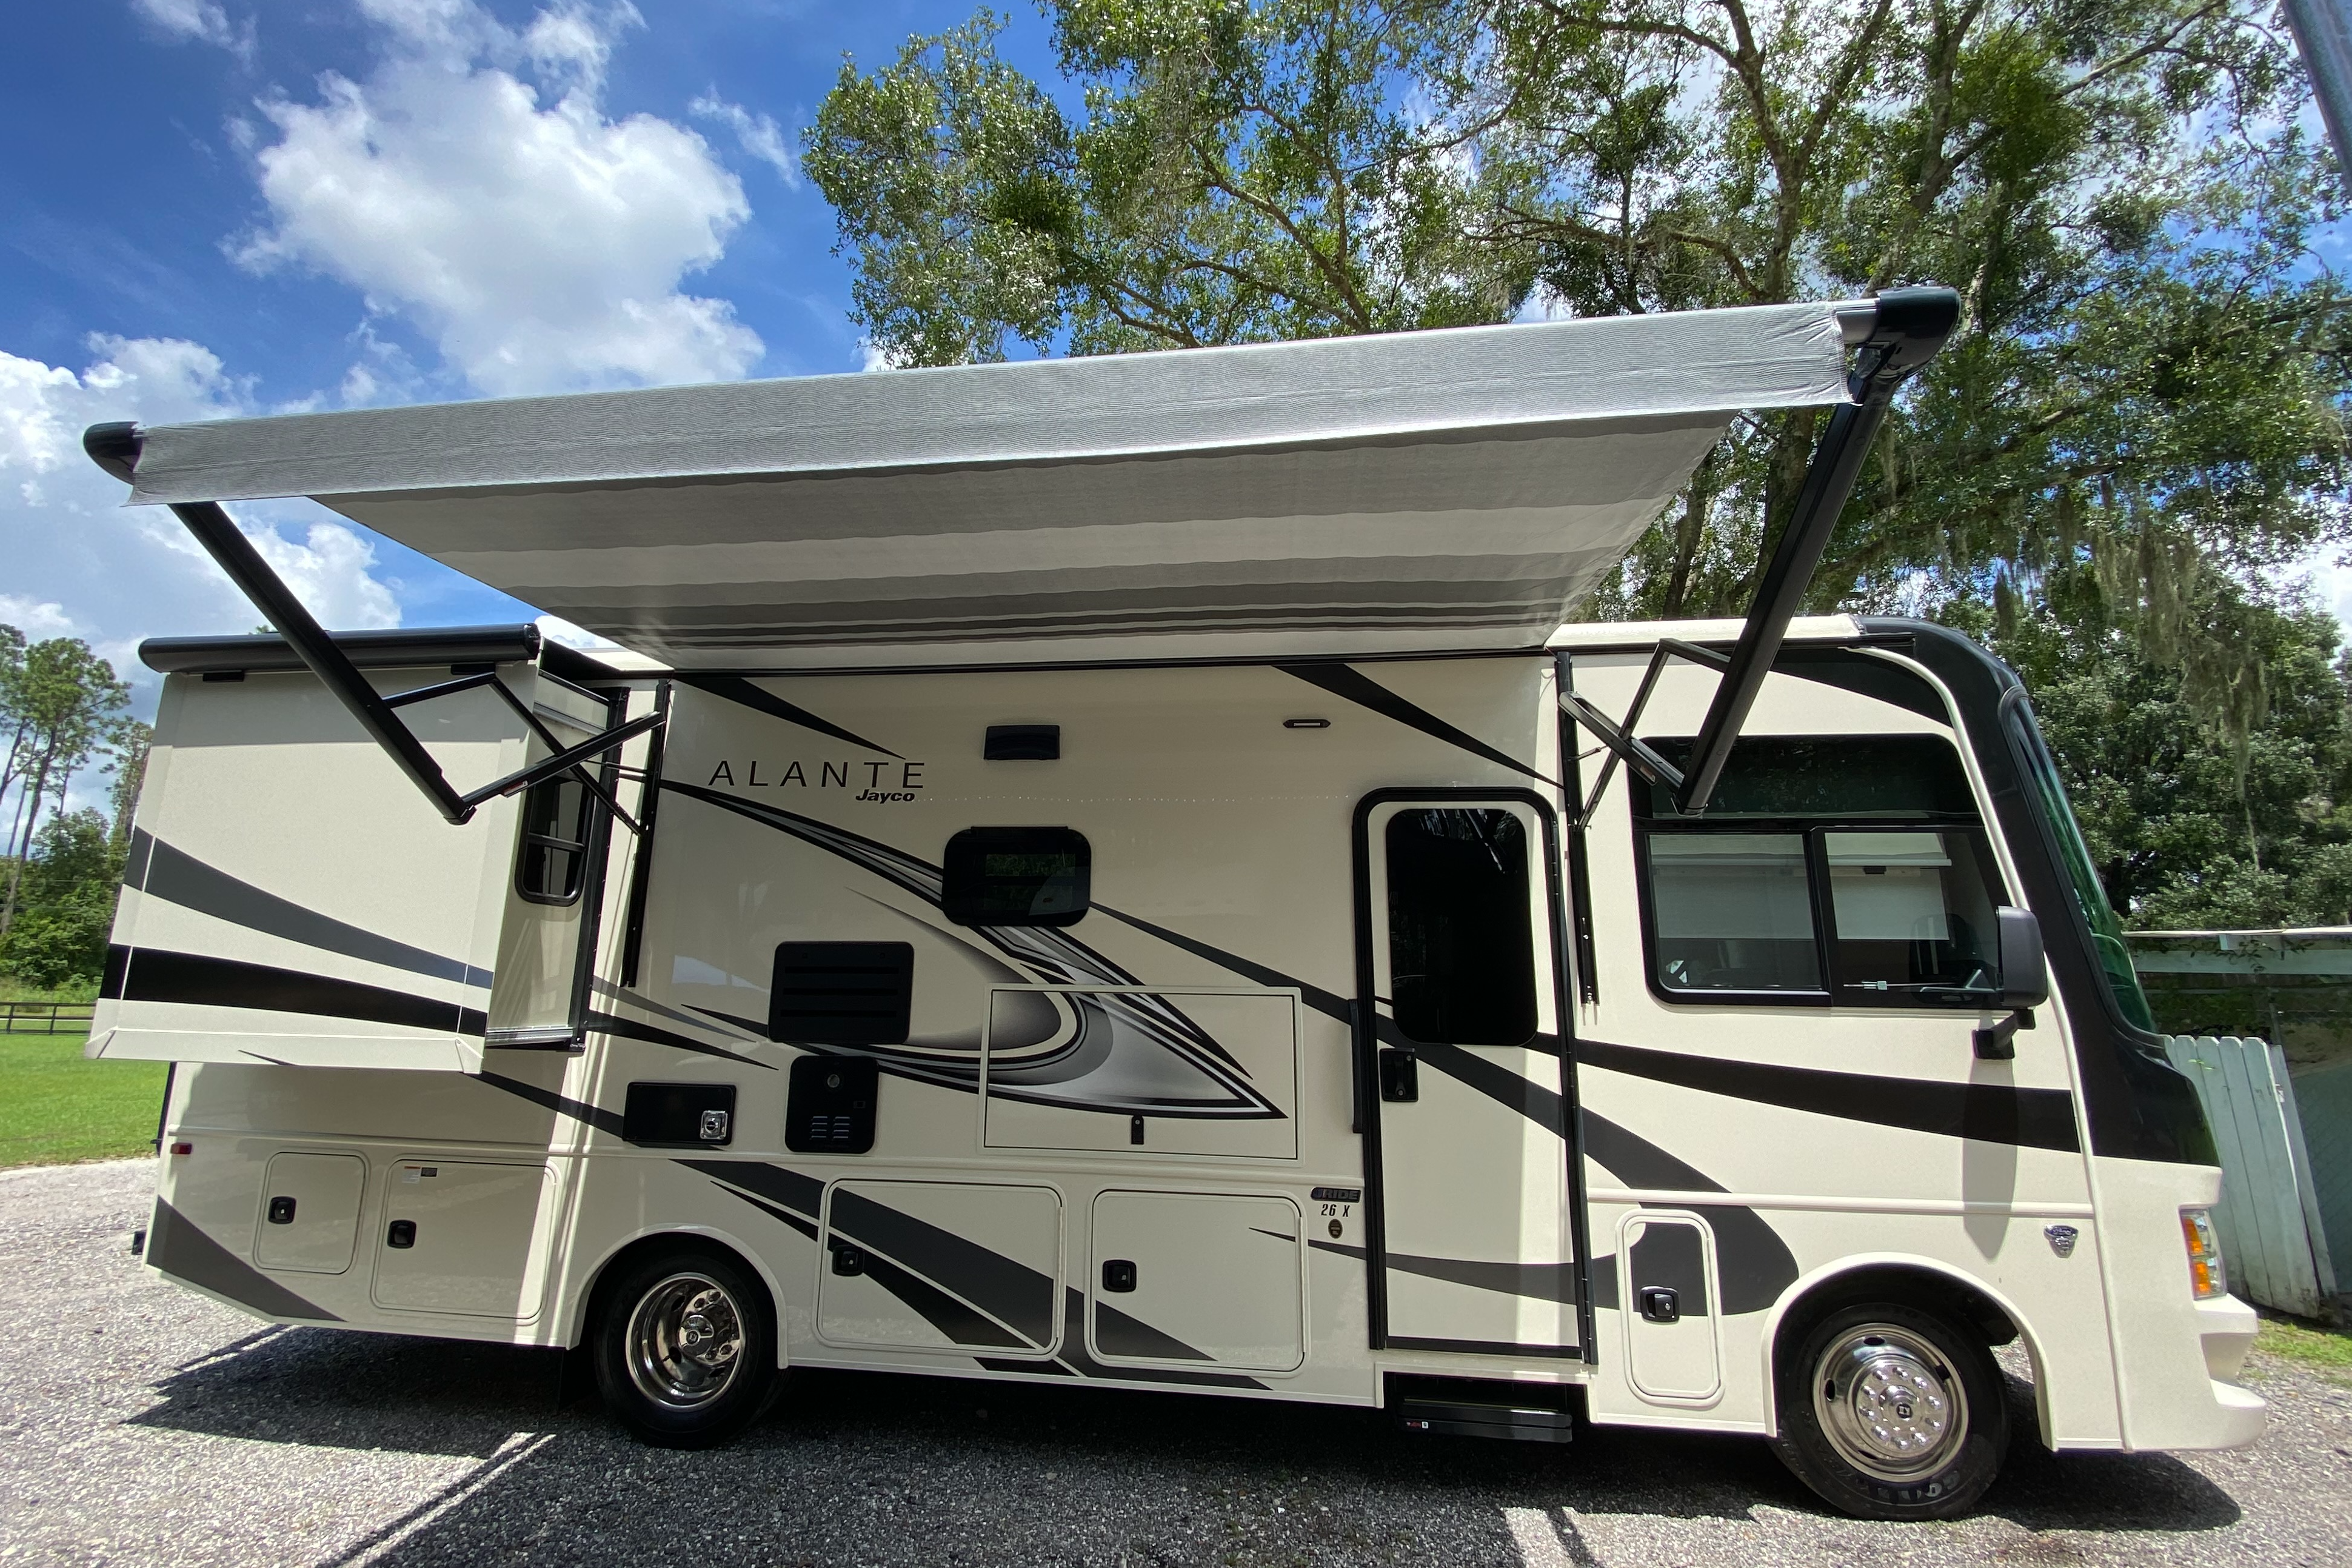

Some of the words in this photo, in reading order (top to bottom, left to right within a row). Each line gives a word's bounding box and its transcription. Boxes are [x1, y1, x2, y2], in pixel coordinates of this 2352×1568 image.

[708, 760, 924, 789] ALANTE
[855, 789, 915, 804] Jayco
[1321, 1203, 1337, 1216] 26
[1342, 1204, 1350, 1217] X
